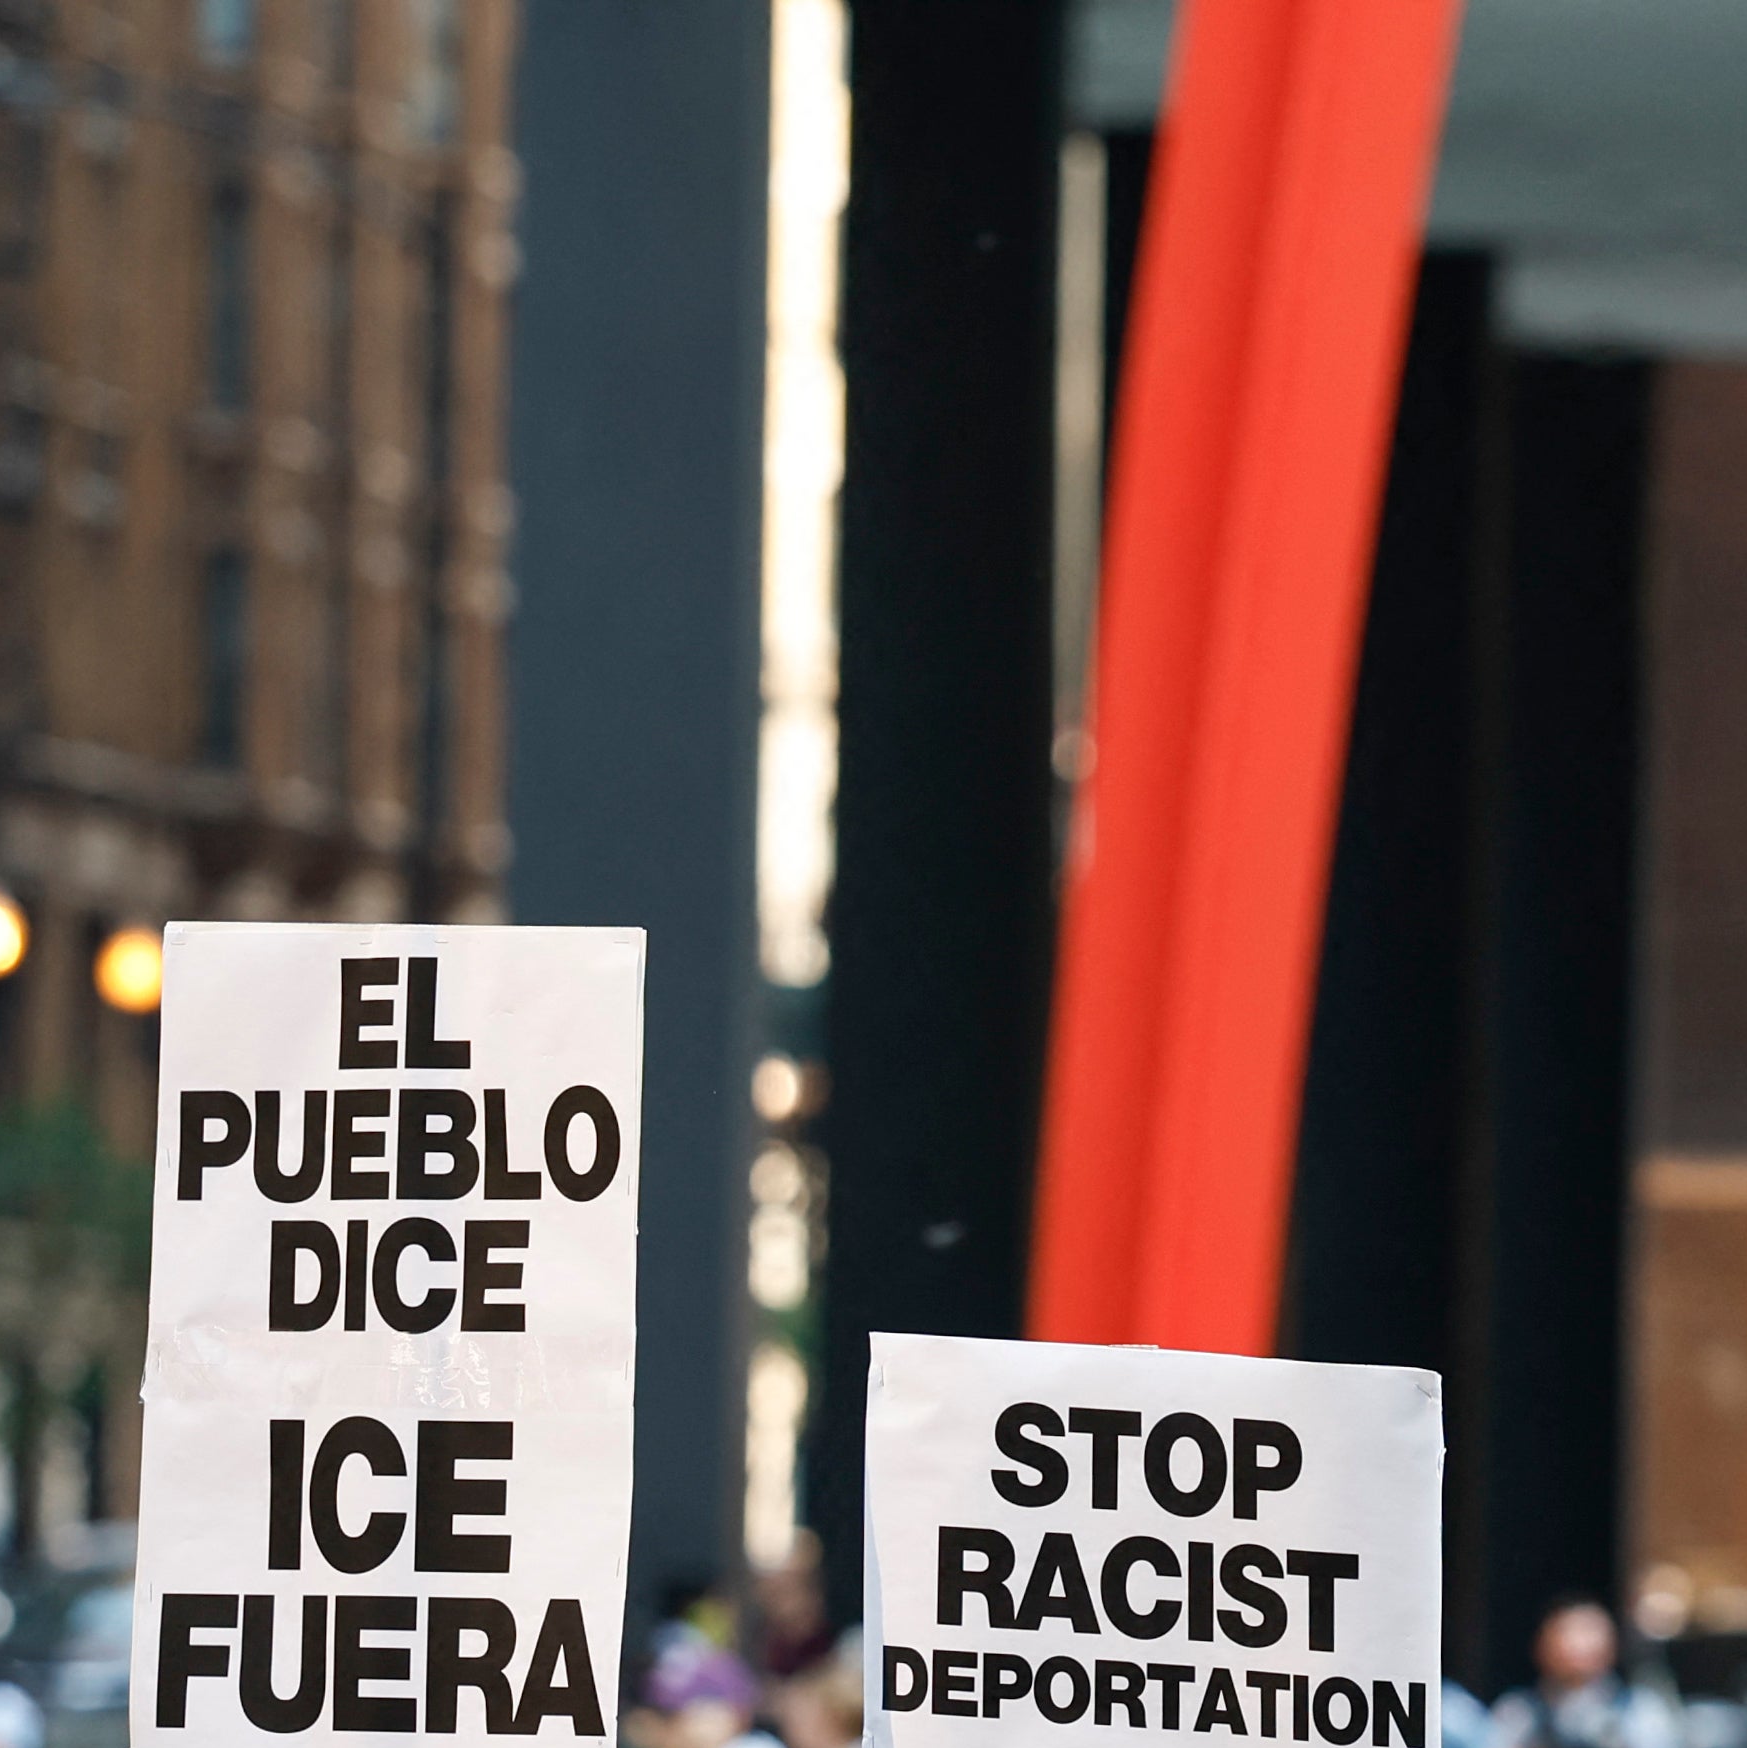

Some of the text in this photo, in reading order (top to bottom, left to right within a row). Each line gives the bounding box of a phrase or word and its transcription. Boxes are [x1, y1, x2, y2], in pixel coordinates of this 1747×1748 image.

[337, 956, 472, 1071] EL
[176, 1084, 622, 1205] PUEBLO
[267, 1216, 531, 1336] DICE
[267, 1415, 515, 1576] ICE
[989, 1401, 1304, 1522] STOP
[935, 1524, 1360, 1654] RACIST
[154, 1592, 608, 1738] FUERA
